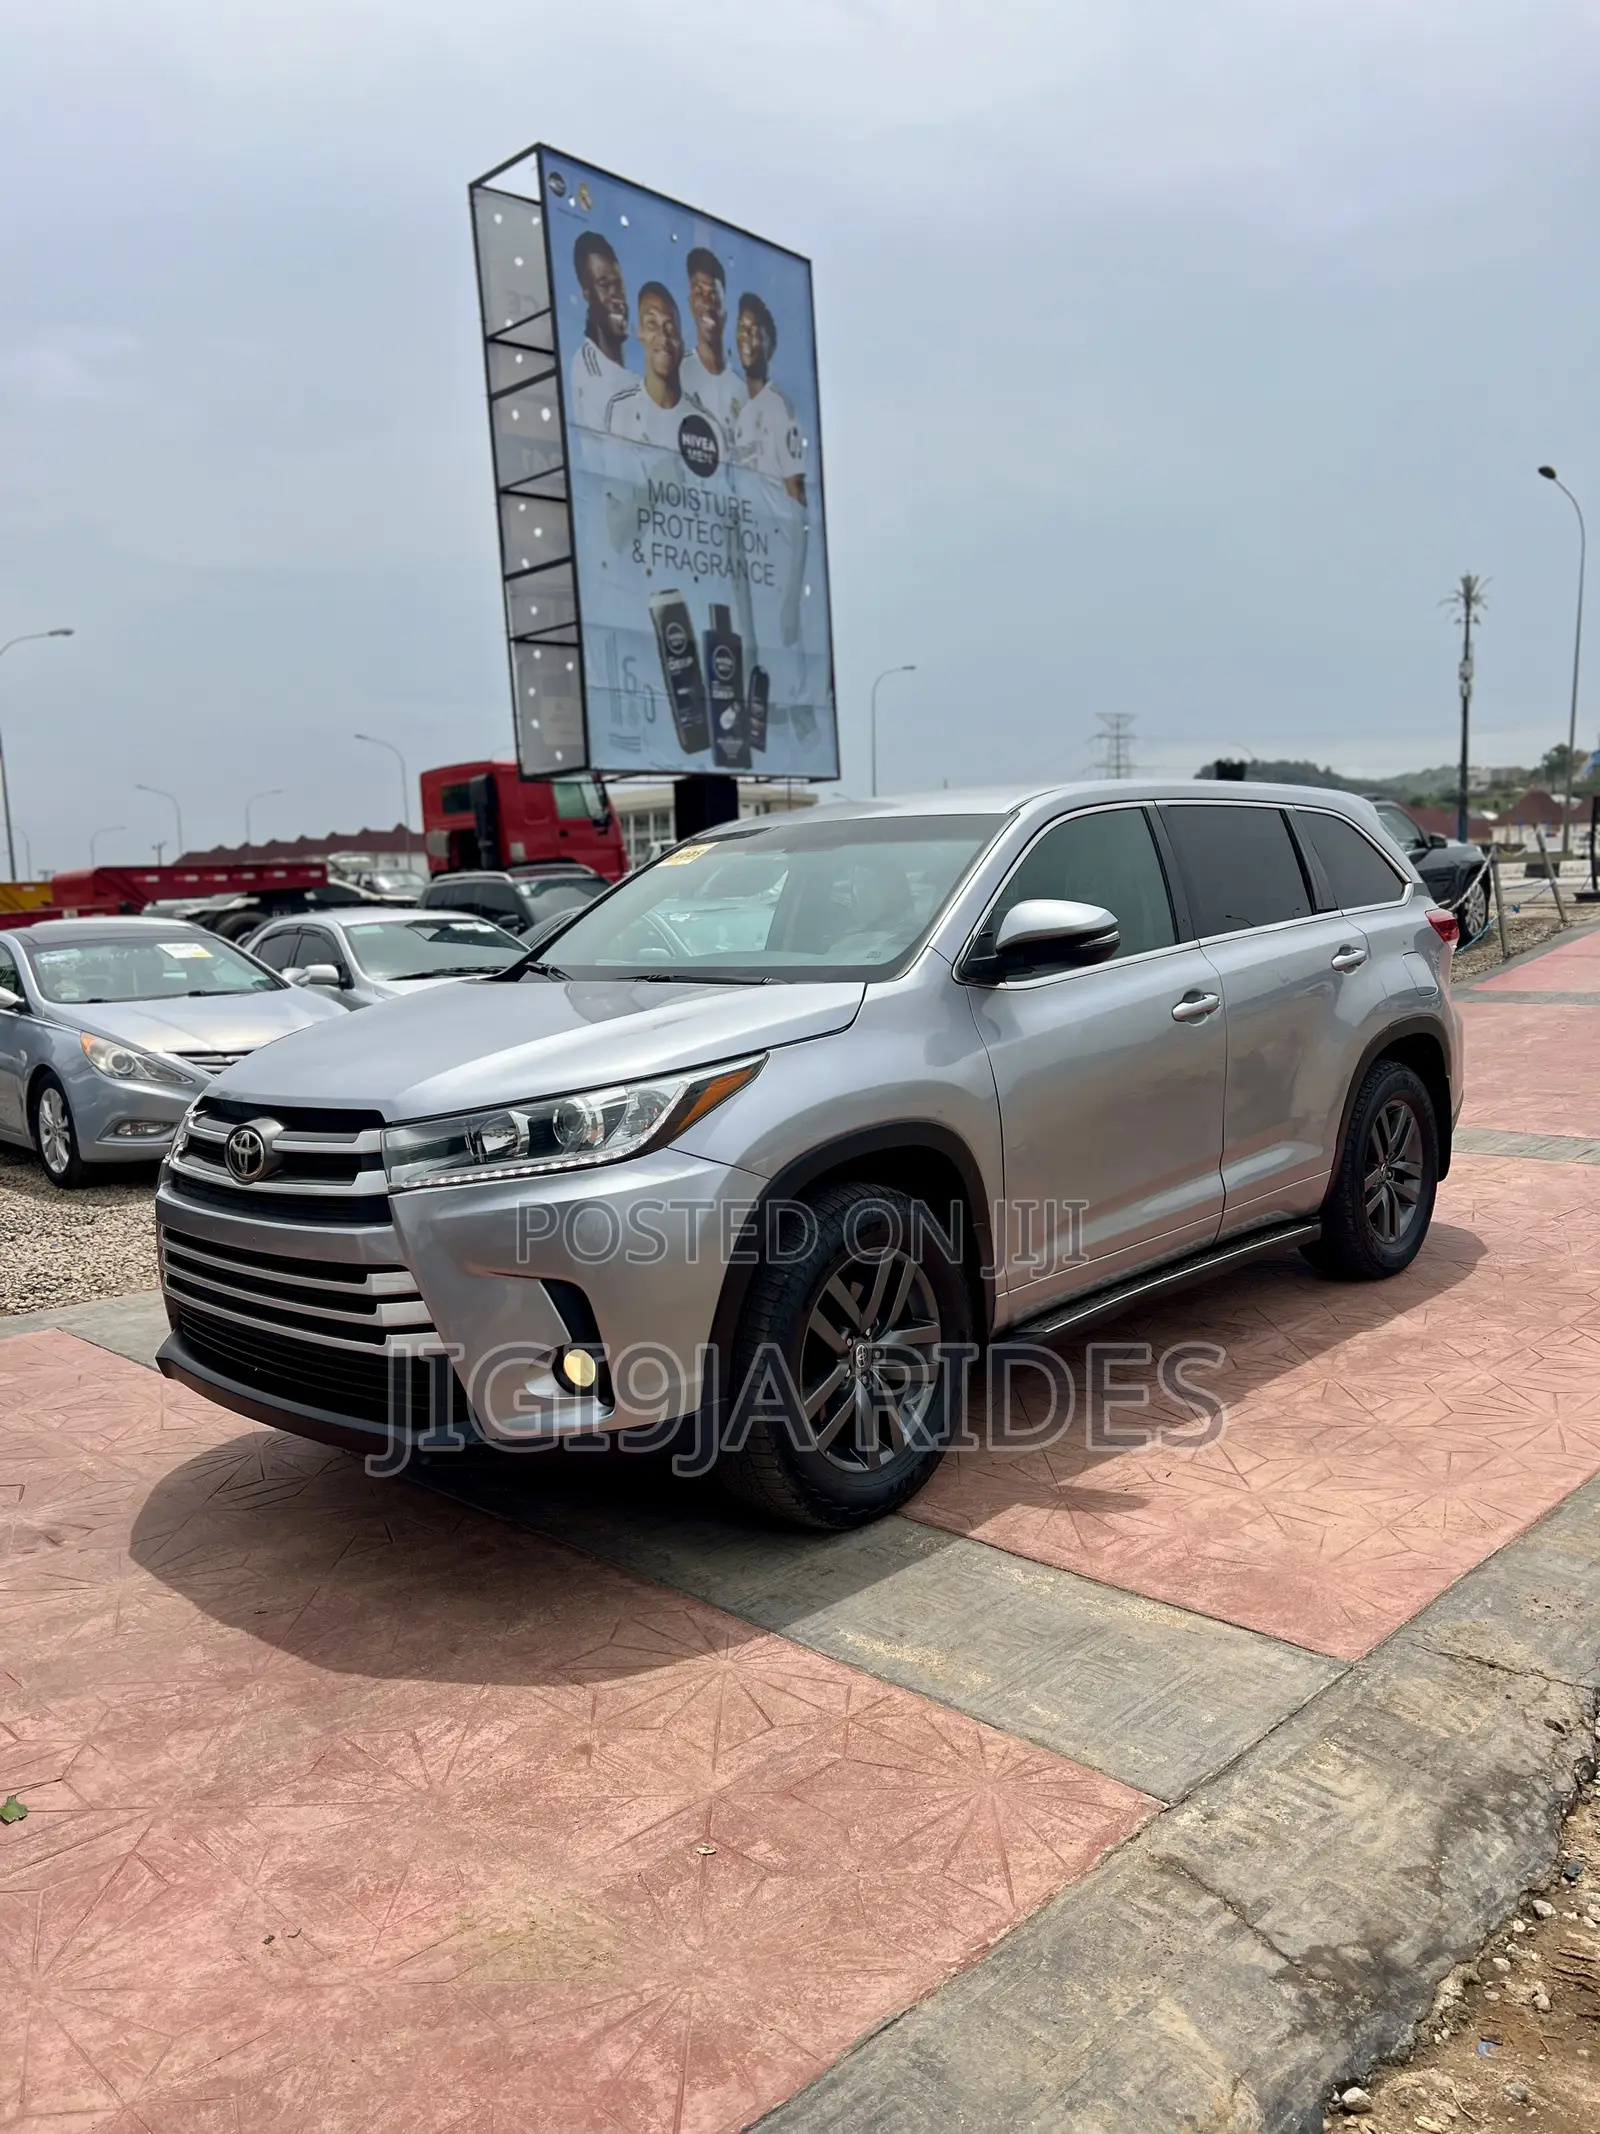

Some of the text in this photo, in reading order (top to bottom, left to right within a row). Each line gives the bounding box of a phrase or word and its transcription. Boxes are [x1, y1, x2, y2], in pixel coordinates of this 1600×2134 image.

[682, 433, 717, 452] NIVEA
[637, 508, 768, 556] PROTECTION
[632, 538, 775, 587] & FRAGRANCE
